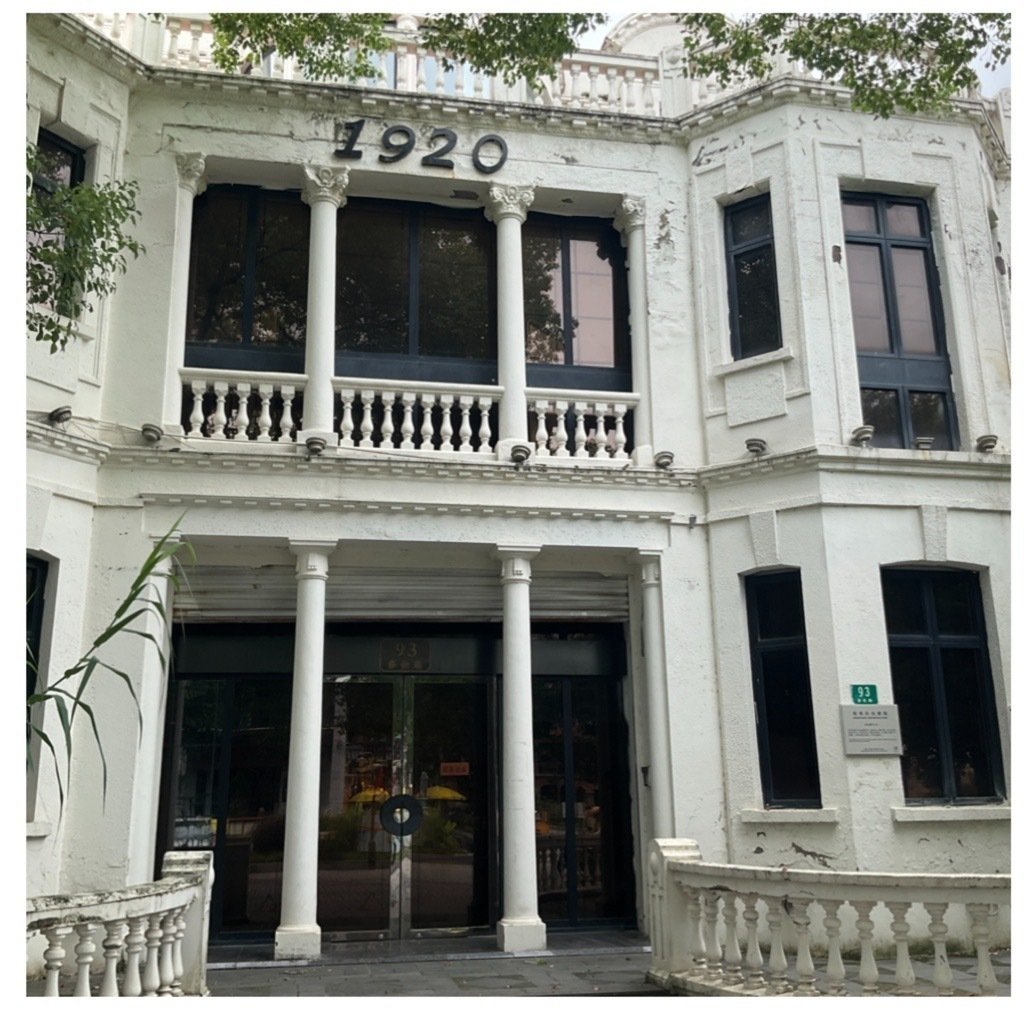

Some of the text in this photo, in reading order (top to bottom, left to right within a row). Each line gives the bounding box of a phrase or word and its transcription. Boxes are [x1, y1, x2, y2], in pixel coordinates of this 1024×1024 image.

[334, 119, 509, 174] 1920
[395, 642, 418, 657] 93
[857, 686, 871, 698] 93
